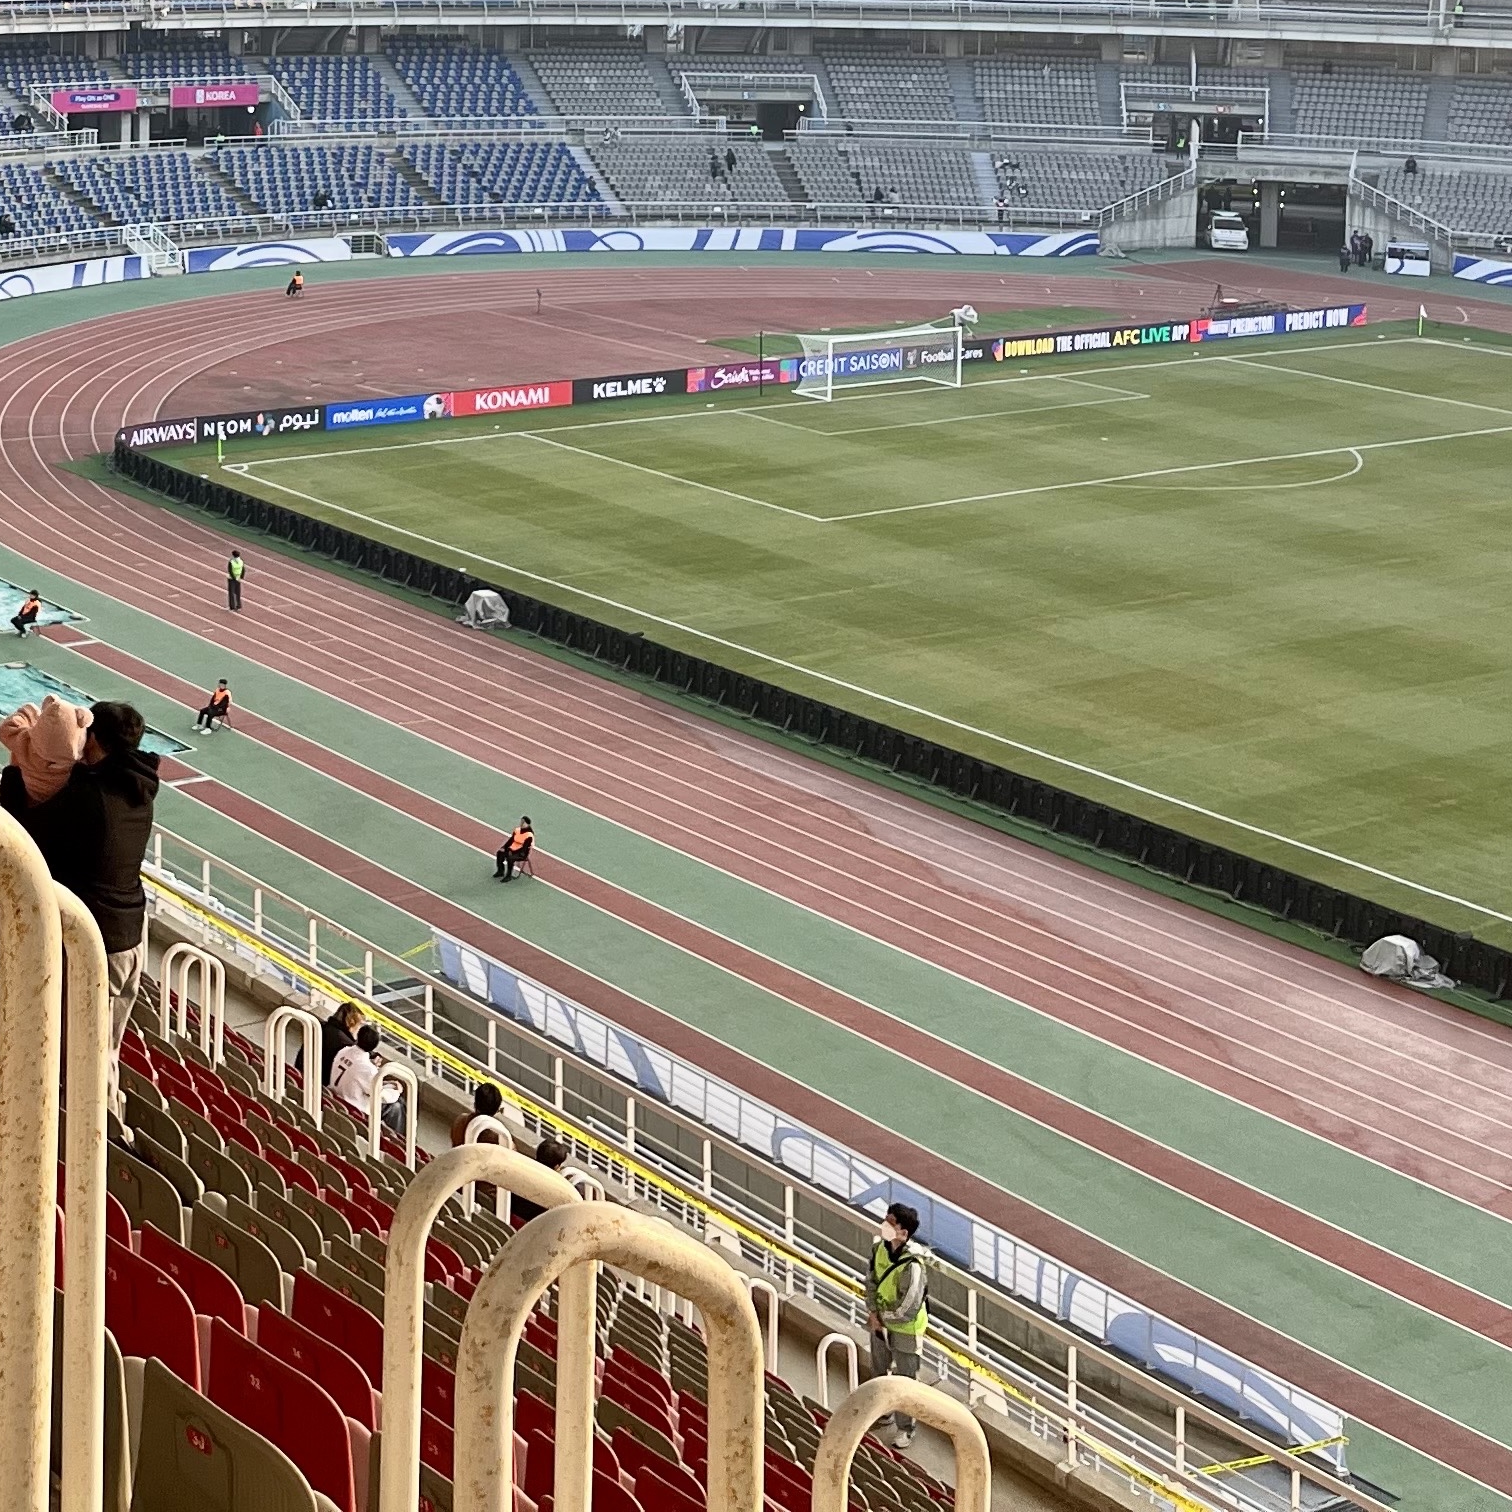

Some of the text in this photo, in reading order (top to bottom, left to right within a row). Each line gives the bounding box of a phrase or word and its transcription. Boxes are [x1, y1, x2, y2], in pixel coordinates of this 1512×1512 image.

[206, 90, 236, 100] KOREA
[1286, 310, 1324, 332] PREDICT
[1005, 337, 1054, 357] DOWNLOAD
[1056, 336, 1072, 352] THE
[1074, 332, 1111, 350] OFFICIAL
[850, 352, 900, 372] SAISON
[476, 386, 549, 411] KONAMI
[593, 378, 652, 399] KELME
[333, 408, 374, 424] molten
[130, 422, 194, 447] AIRWAYS
[204, 419, 252, 437] NEOM
[334, 1065, 346, 1086] 7
